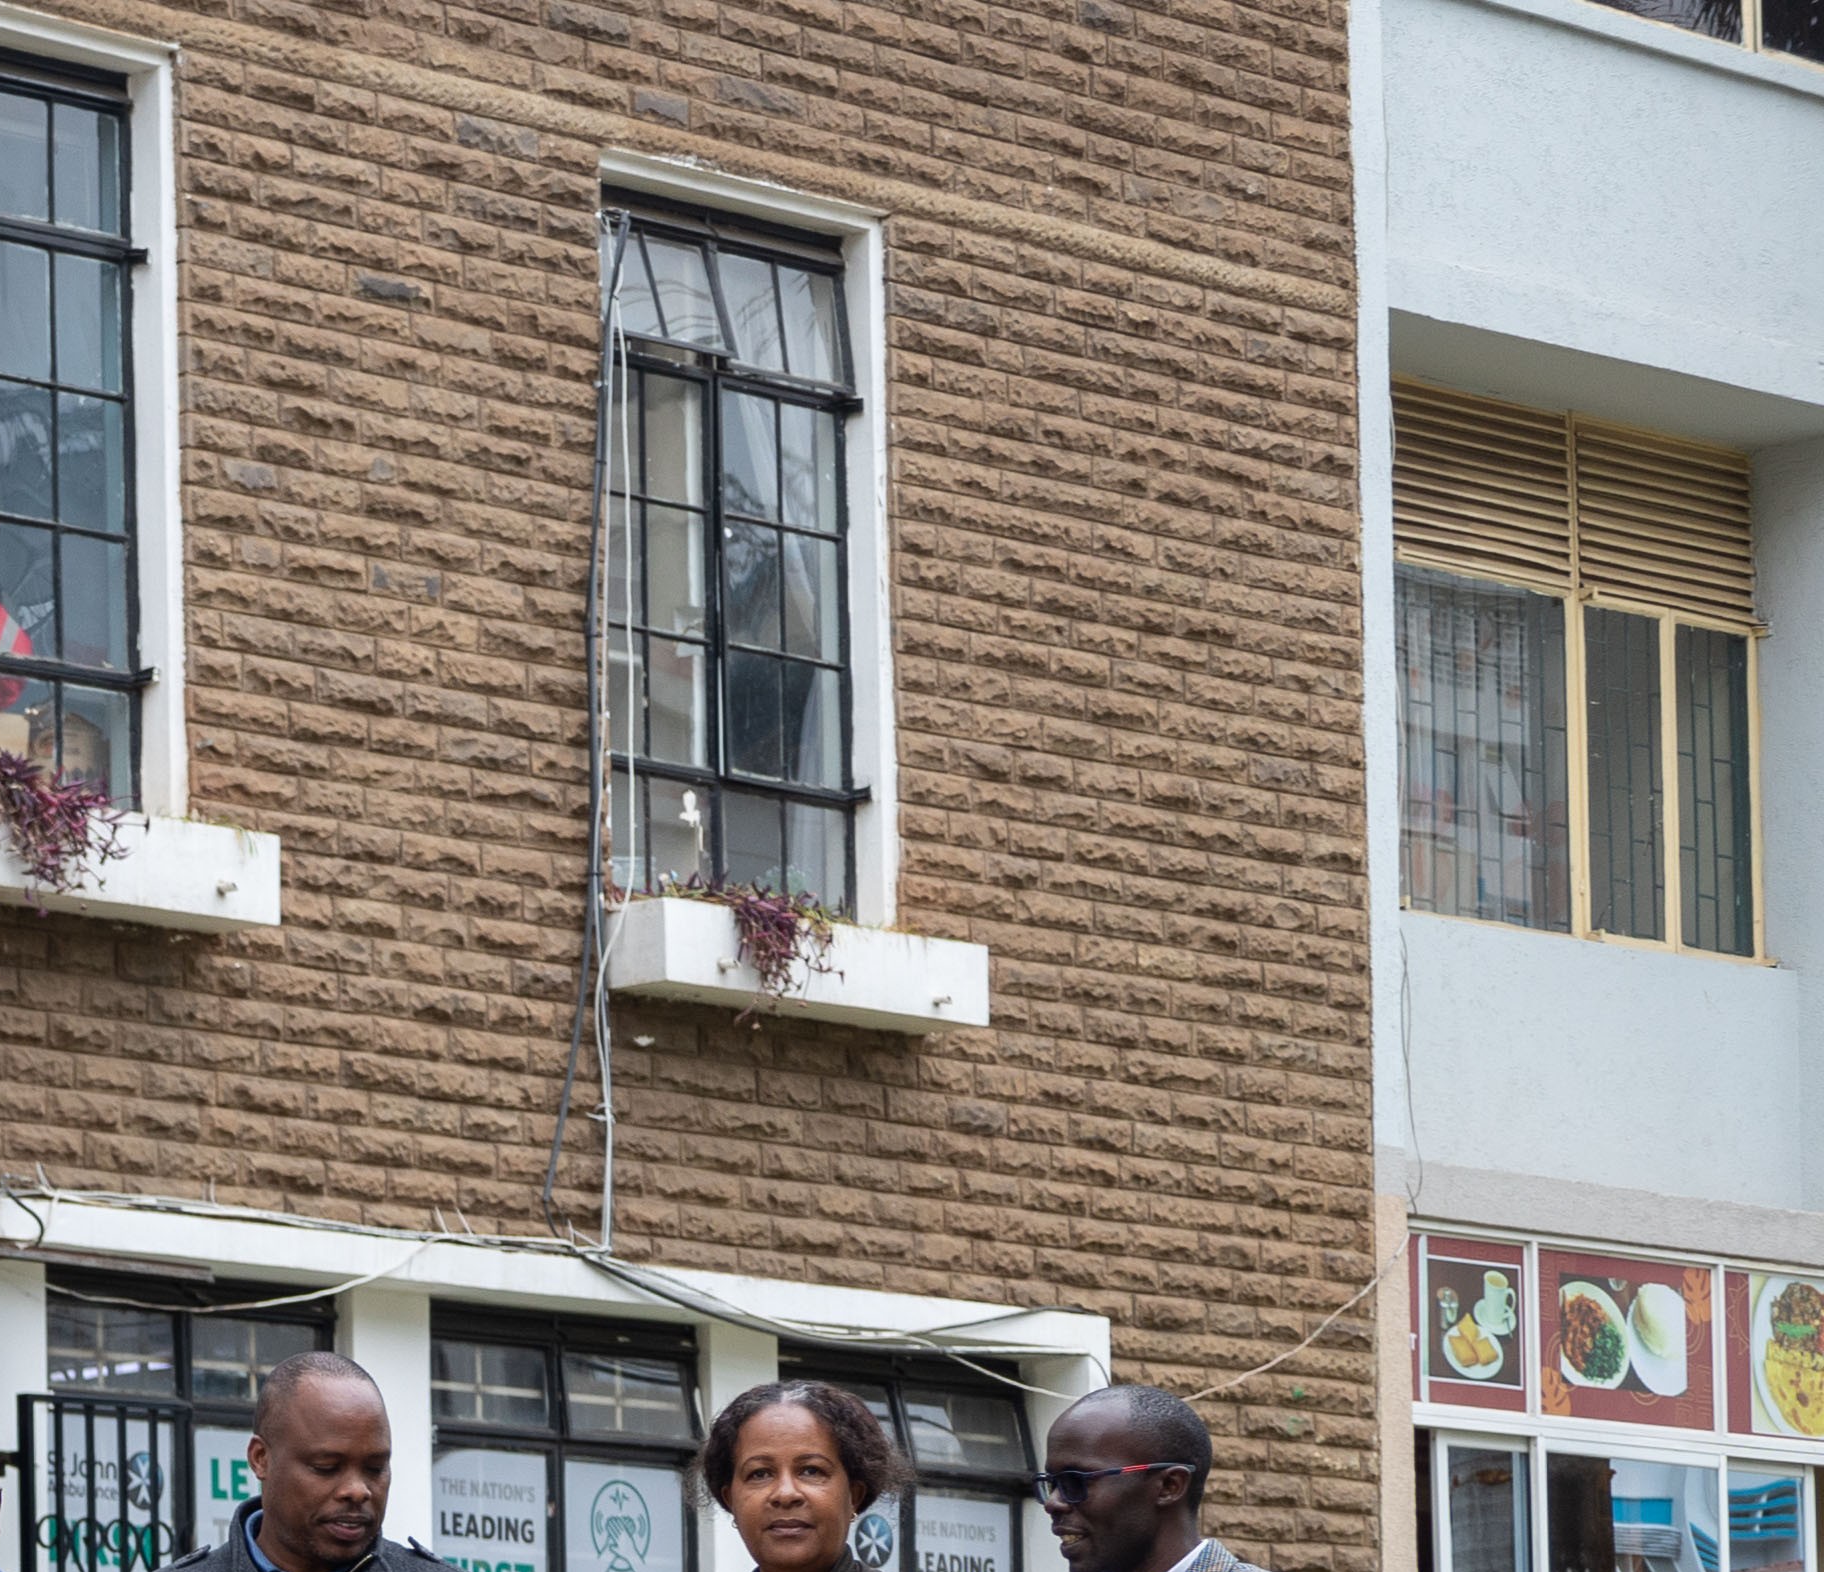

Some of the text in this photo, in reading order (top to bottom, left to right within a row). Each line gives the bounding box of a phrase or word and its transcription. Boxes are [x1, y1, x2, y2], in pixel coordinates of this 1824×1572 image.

[440, 1477, 536, 1503] THE NATION'S
[440, 1510, 535, 1544] LEADING
[940, 1521, 996, 1543] NATION'S
